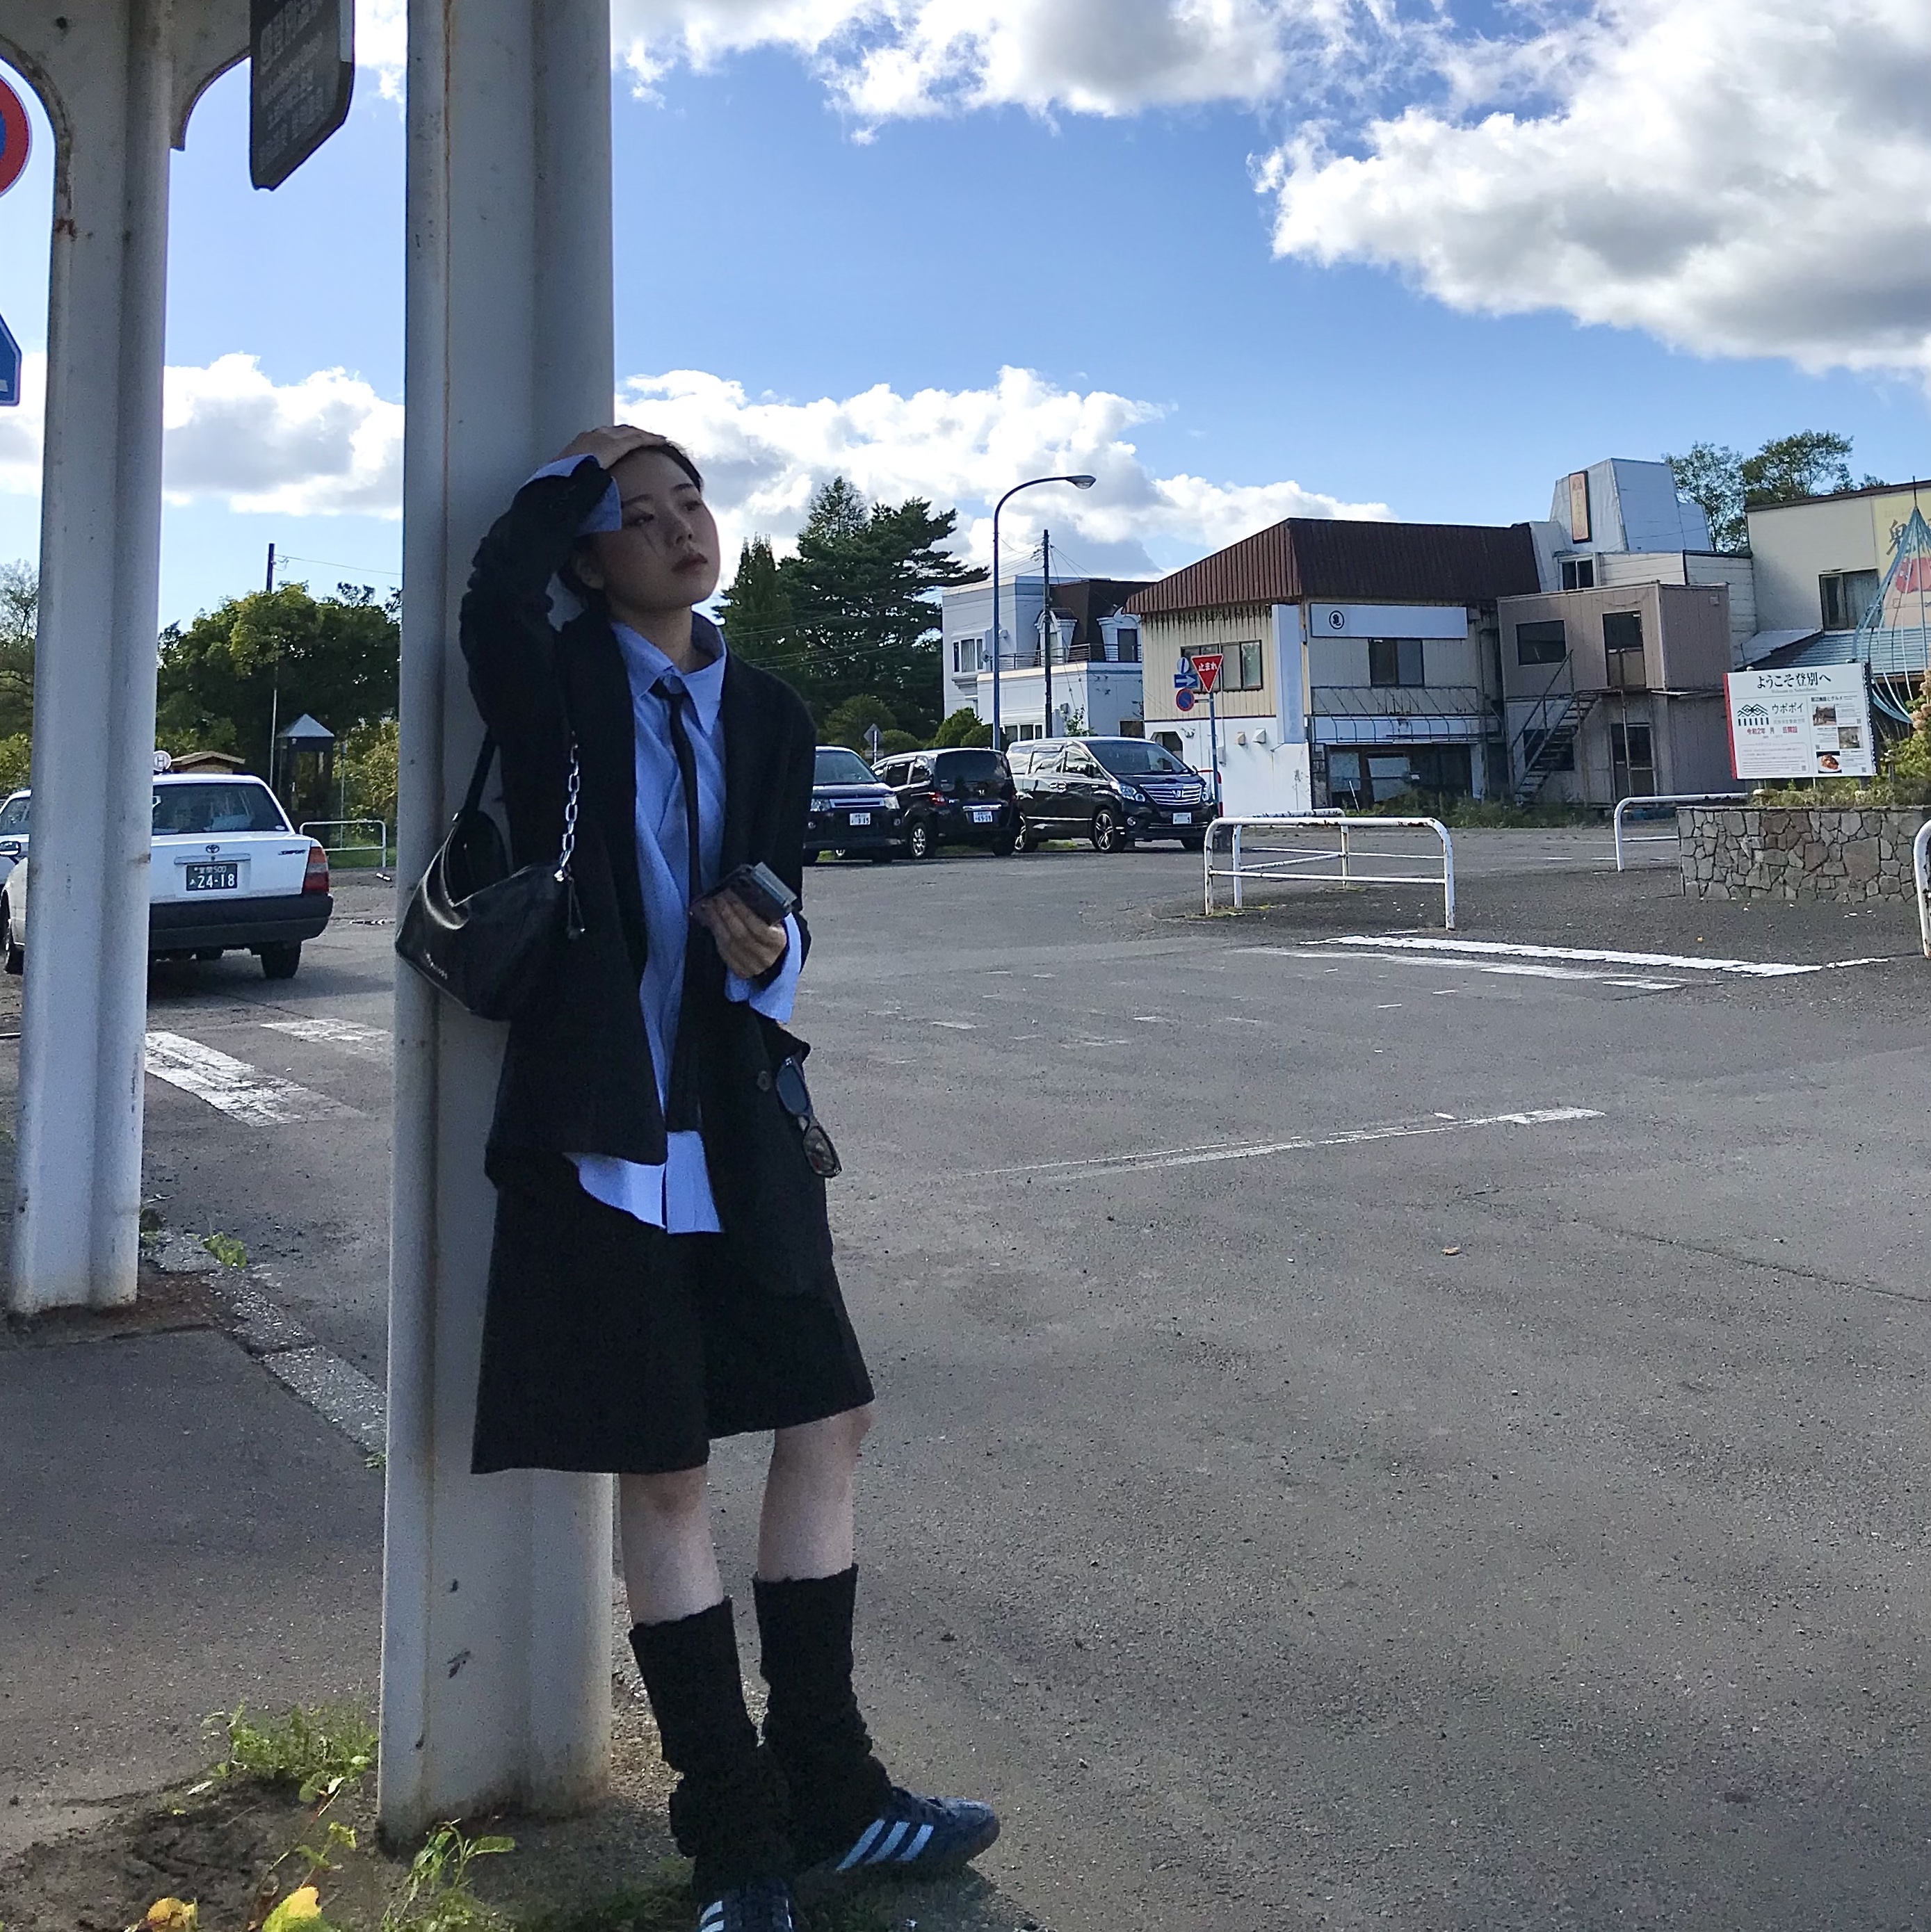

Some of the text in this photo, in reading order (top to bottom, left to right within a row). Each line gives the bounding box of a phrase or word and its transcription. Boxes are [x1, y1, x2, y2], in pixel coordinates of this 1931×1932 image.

[1198, 661, 1218, 672] 止まれ
[1756, 672, 1831, 689] ようこそ登別へ
[1771, 701, 1804, 715] ウポポイ
[157, 756, 165, 766] H
[197, 873, 235, 888] 24-18
